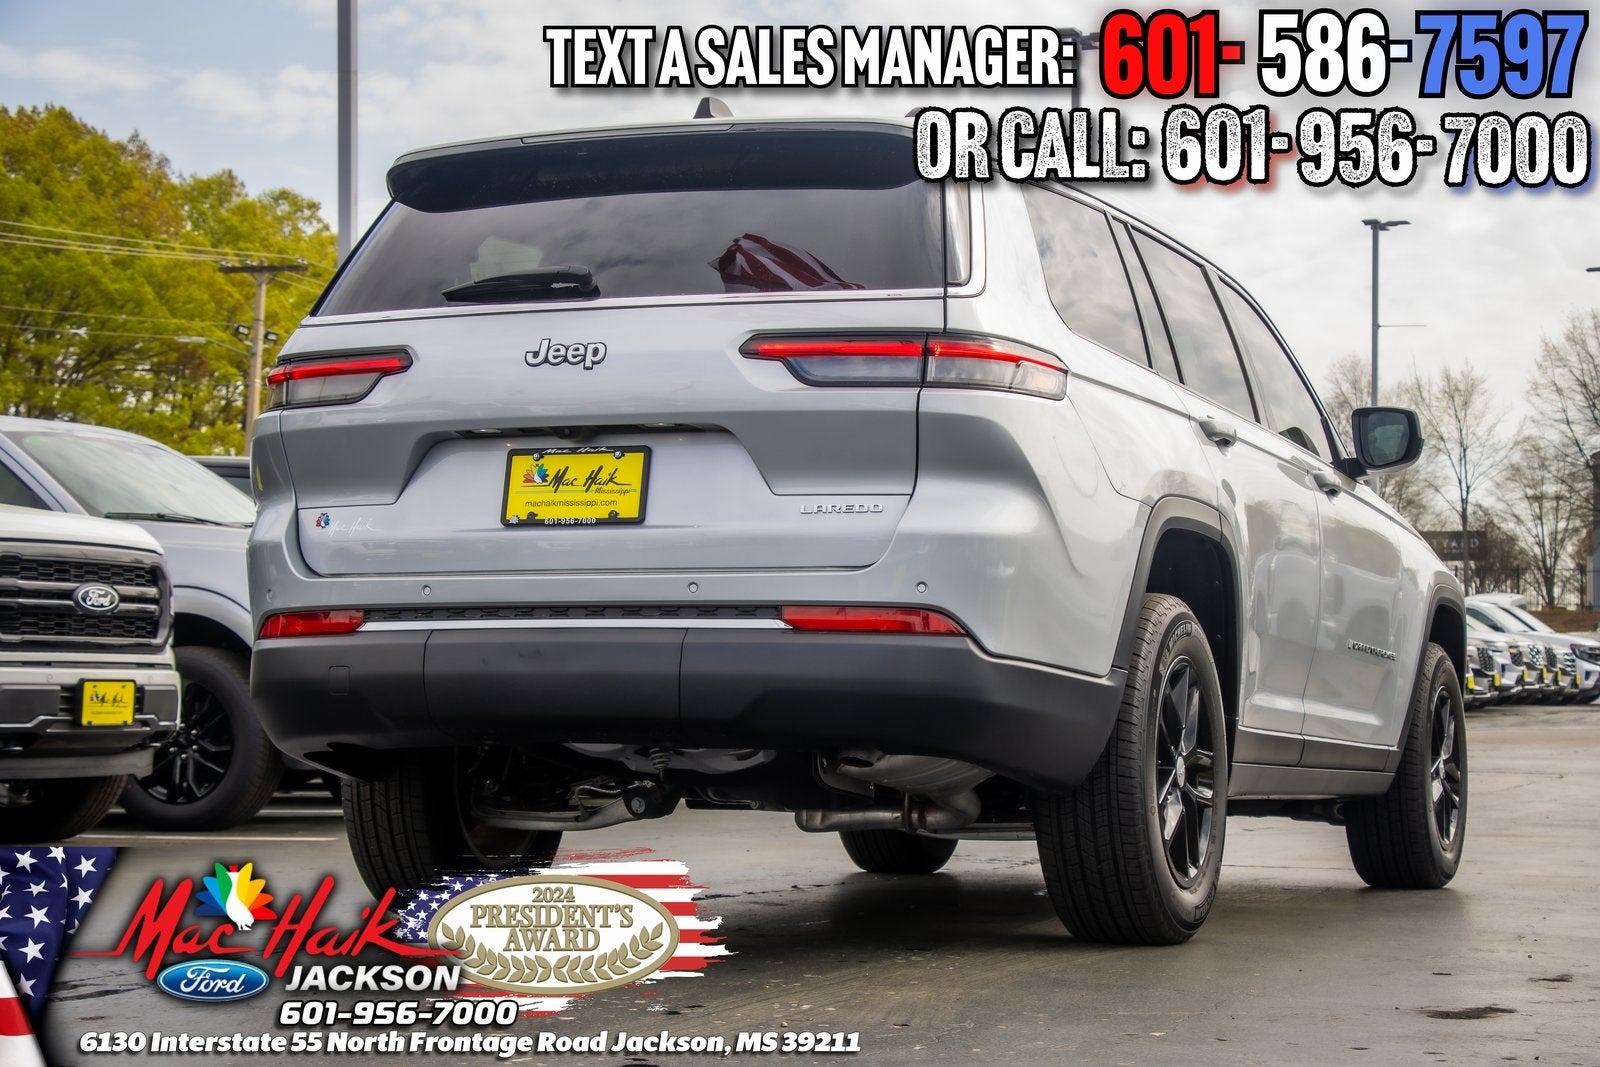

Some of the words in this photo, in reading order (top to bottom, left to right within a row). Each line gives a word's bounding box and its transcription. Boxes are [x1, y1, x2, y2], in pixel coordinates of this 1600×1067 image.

[524, 338, 607, 370] Jeep
[548, 465, 581, 494] Mac
[582, 465, 624, 493] Haik
[594, 487, 631, 496] Mississippi
[525, 499, 618, 508] machaikmississippi.com
[800, 503, 883, 514] LAREDO
[544, 517, 596, 525] 601-956-7000
[86, 589, 111, 607] Ford
